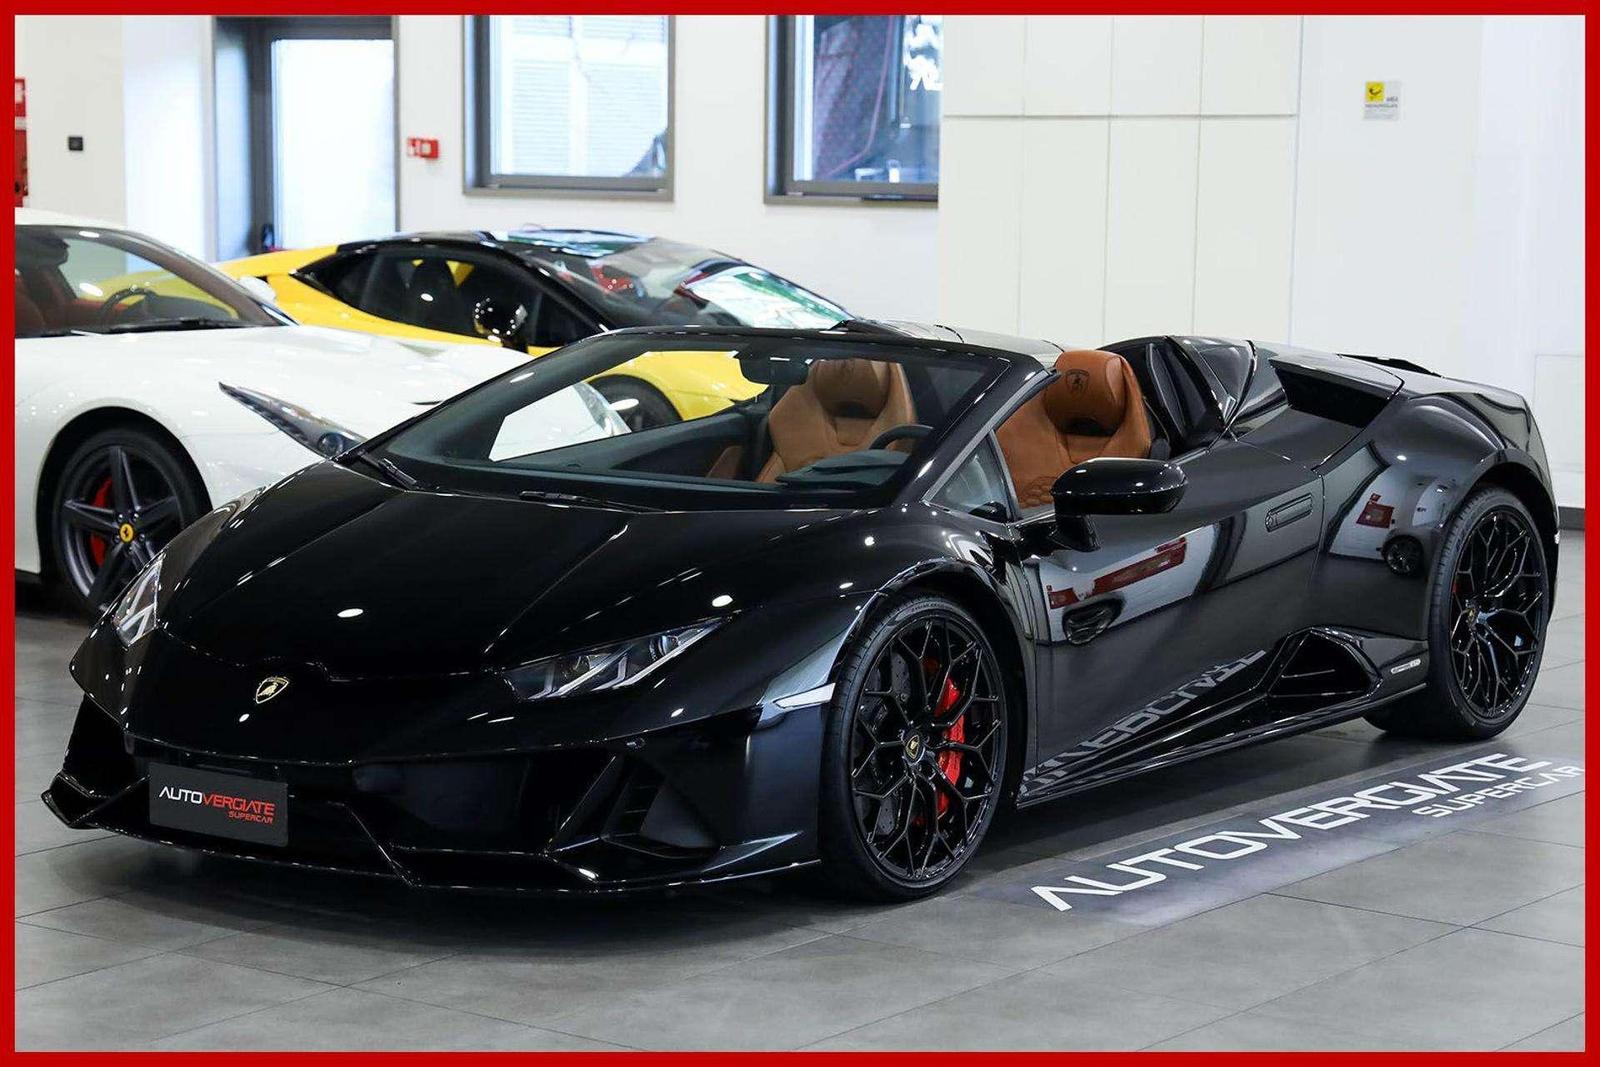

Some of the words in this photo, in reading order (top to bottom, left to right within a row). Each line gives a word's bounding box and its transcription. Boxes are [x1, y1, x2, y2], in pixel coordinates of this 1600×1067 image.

[159, 786, 275, 816] AUTOVERGIATE
[1412, 765, 1585, 818] SUPERCAR
[228, 811, 273, 824] SUPERCAR
[1032, 753, 1552, 911] AUTOVERGIATE
